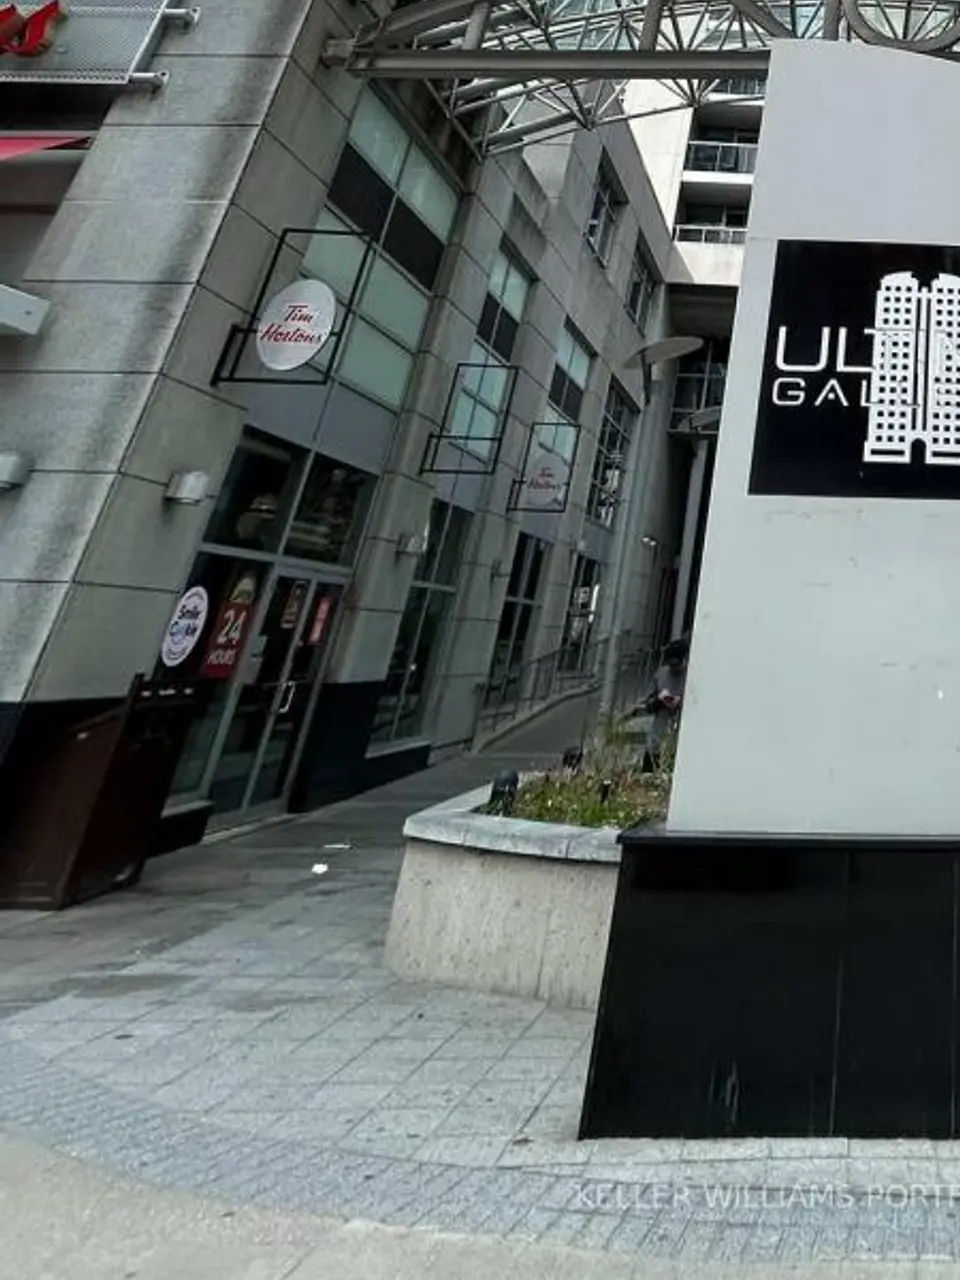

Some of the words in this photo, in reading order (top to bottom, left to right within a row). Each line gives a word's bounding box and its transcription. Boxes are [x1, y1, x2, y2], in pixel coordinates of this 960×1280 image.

[285, 305, 313, 323] Tim
[260, 324, 322, 343] Hortons
[217, 609, 247, 646] 24
[207, 649, 237, 666] HOURS
